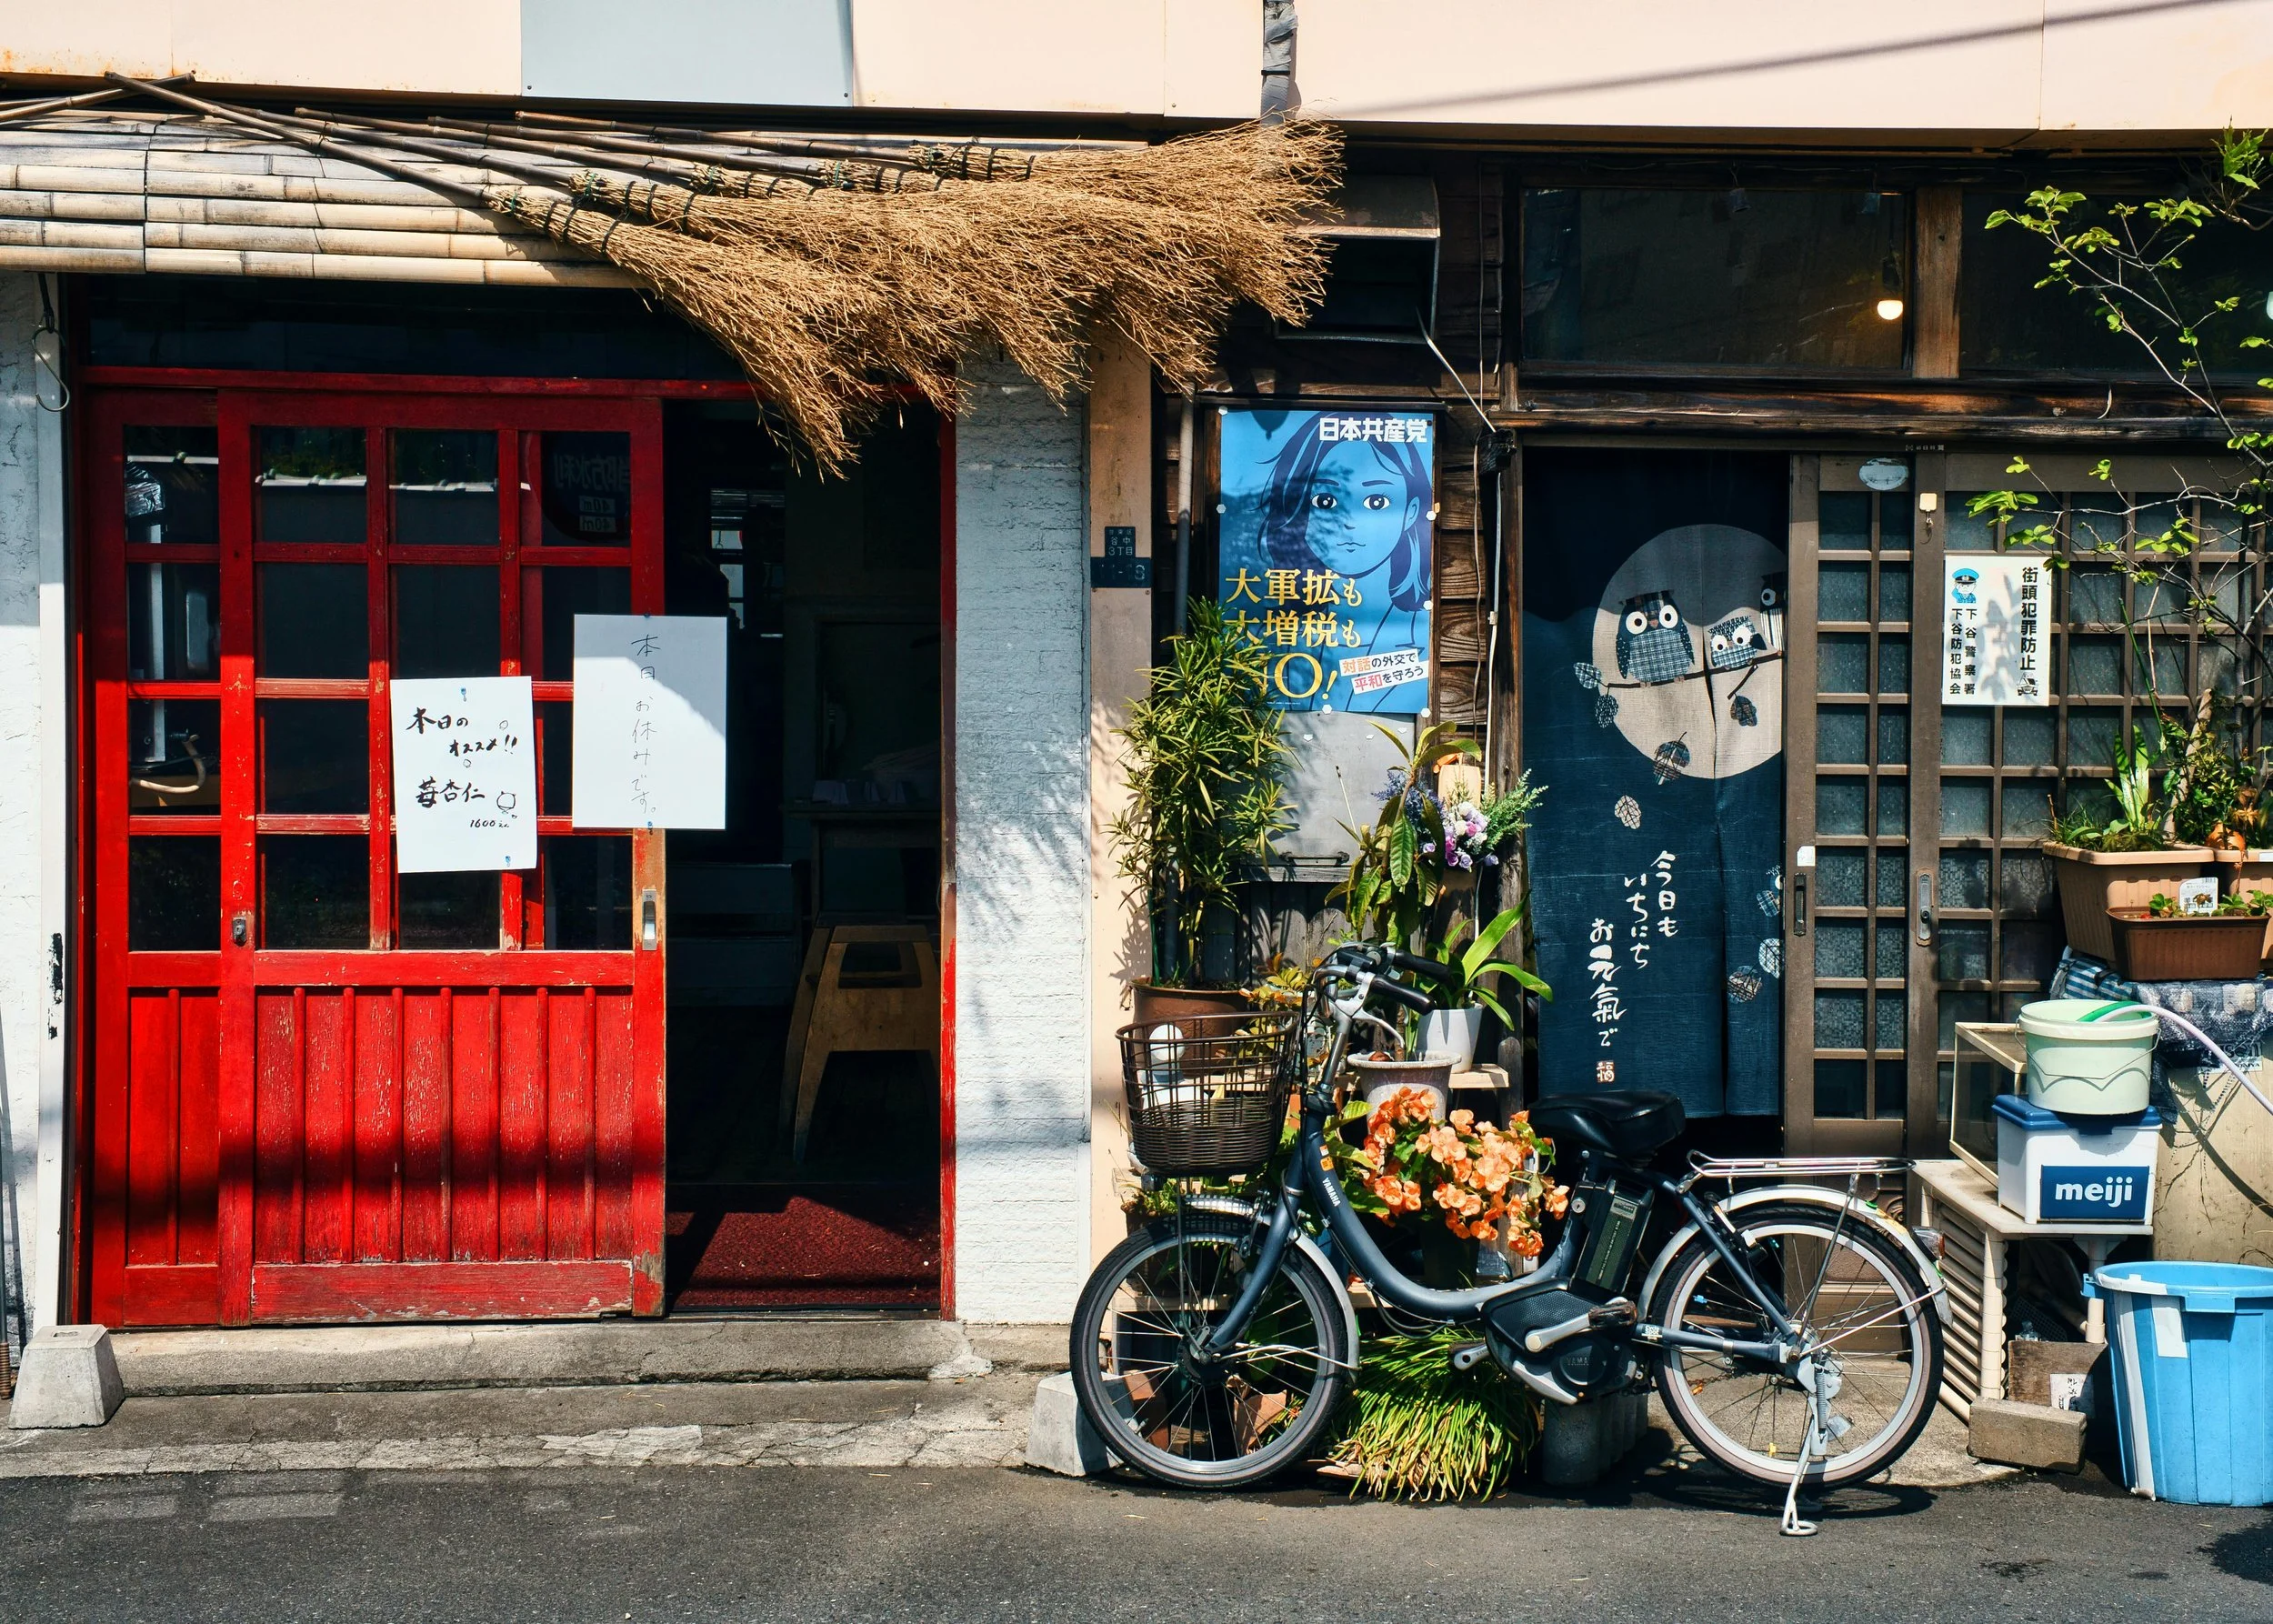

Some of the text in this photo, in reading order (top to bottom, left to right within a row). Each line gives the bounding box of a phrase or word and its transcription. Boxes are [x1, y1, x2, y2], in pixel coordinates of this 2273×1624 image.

[1319, 417, 1427, 443] 日本共産党
[1108, 546, 1133, 556] 3丁目
[1225, 567, 1363, 607] 大軍拡も
[2019, 566, 2038, 671] 街頭犯罪防止
[1342, 652, 1417, 675] 対話の外交で
[1949, 608, 1963, 695] 下谷防犯協会
[1964, 608, 1978, 695] 下谷警察署
[1354, 665, 1426, 692] 平和を守ろう
[406, 707, 469, 734] 本日の
[416, 776, 486, 808] 苺杏仁
[1651, 850, 1678, 937] 今日も
[1624, 873, 1650, 969] いちにち
[1322, 1177, 1341, 1208] YAMAHA
[2055, 1176, 2134, 1208] meiji
